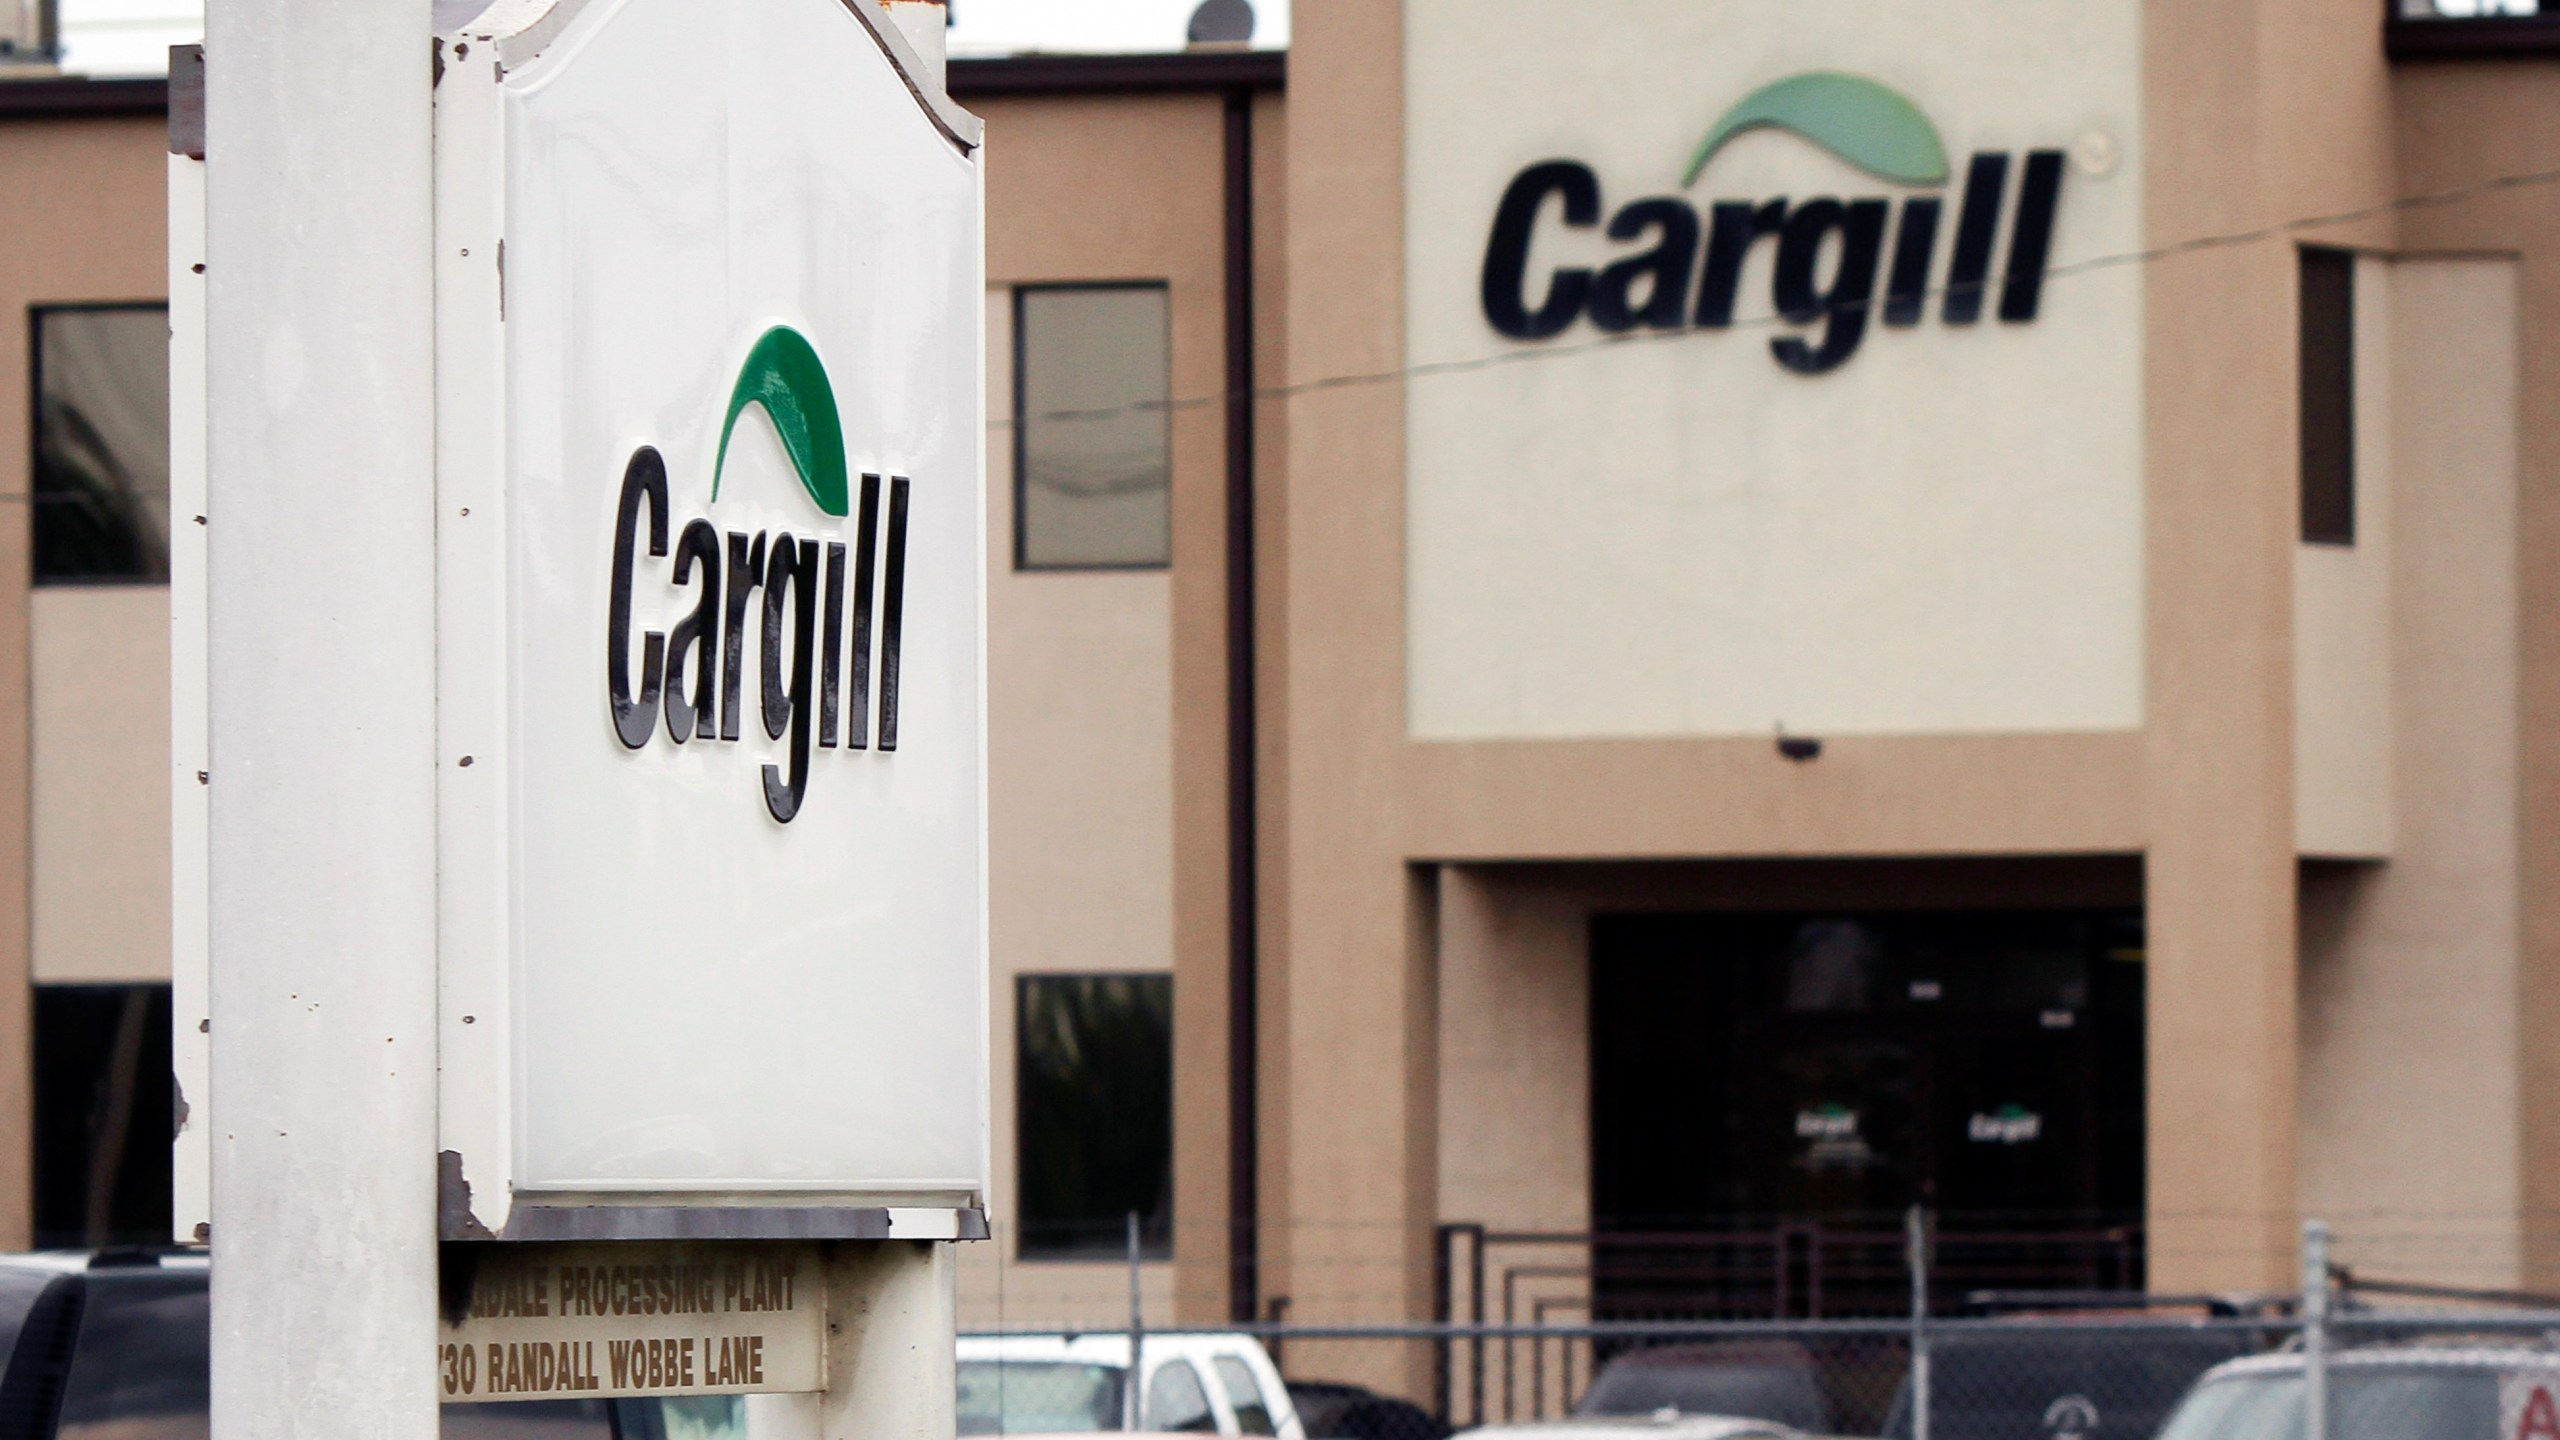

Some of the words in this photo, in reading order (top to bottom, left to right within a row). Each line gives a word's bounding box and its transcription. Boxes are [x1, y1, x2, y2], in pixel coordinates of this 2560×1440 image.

[1481, 149, 2067, 375] Cargill
[608, 445, 910, 824] Cargill
[560, 1264, 715, 1316] PROCESSING
[724, 1260, 796, 1312] PLANT
[488, 1340, 599, 1393] RANDALL
[609, 1338, 694, 1389] WOBBE
[704, 1336, 763, 1386] LANE
